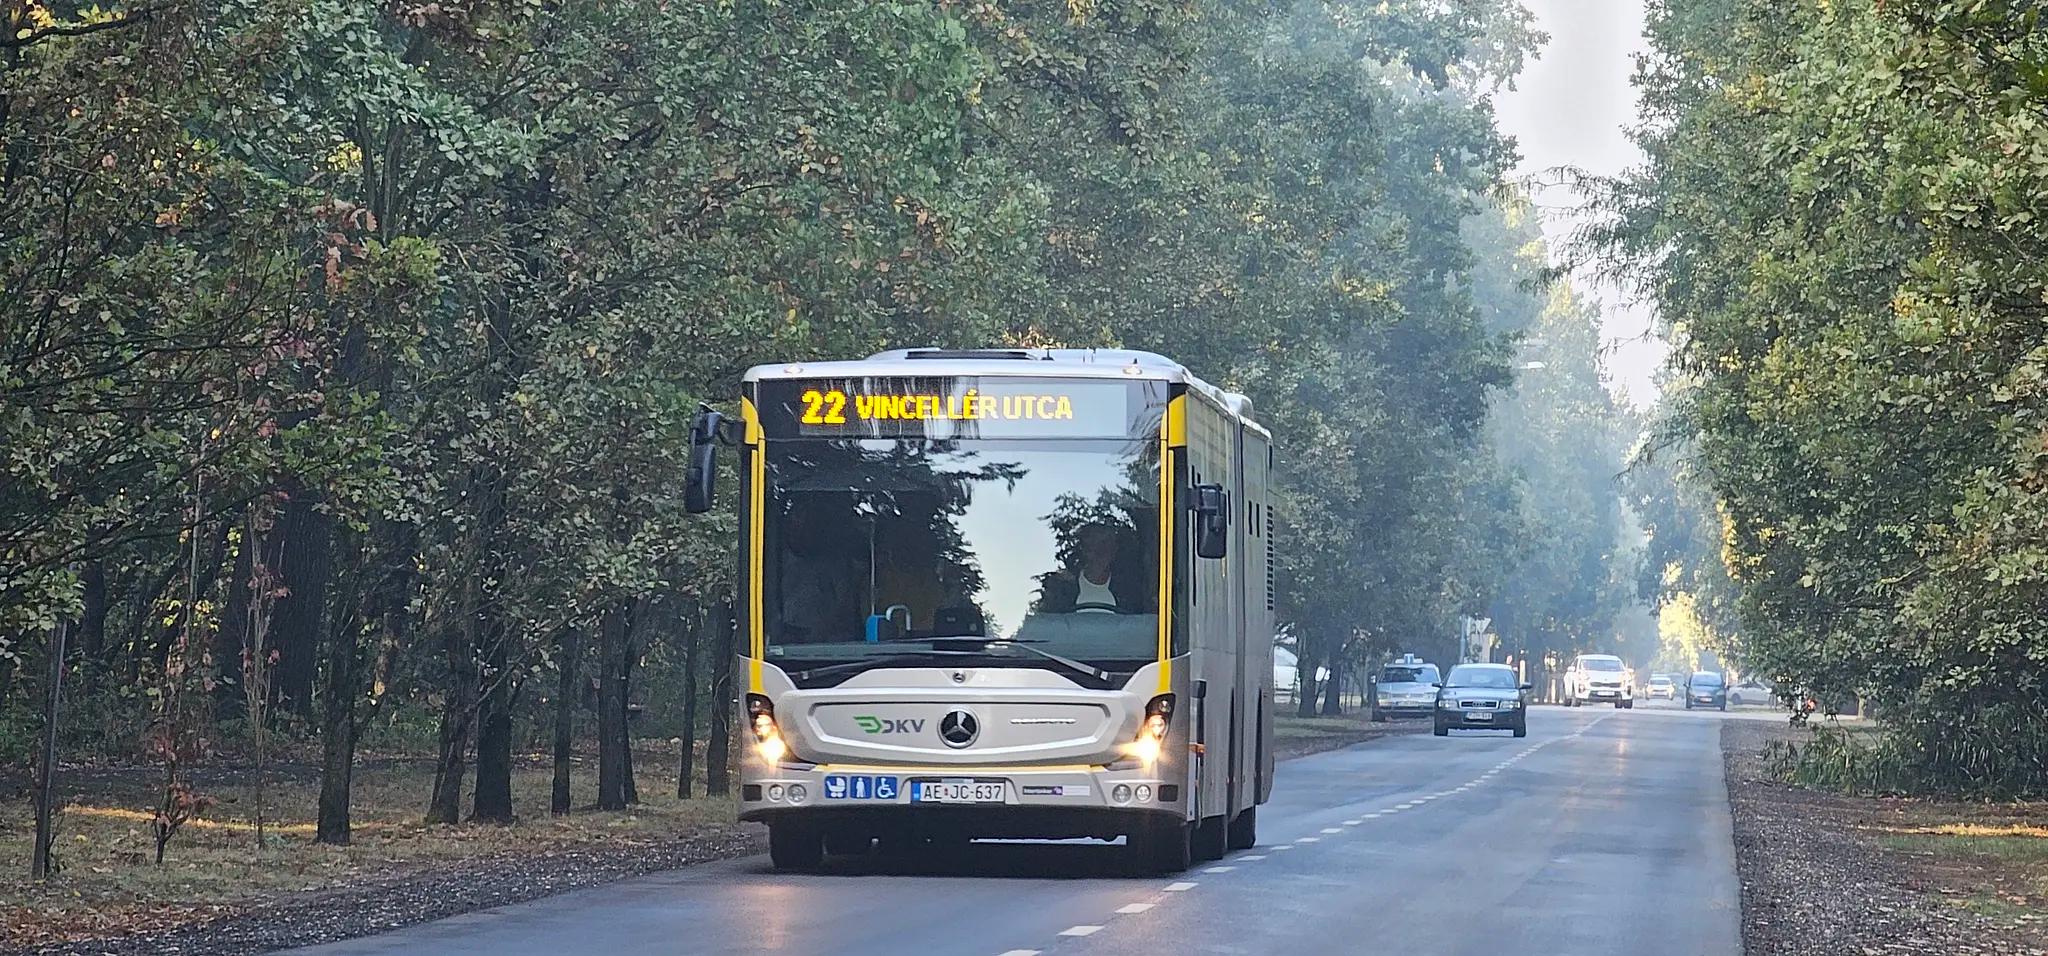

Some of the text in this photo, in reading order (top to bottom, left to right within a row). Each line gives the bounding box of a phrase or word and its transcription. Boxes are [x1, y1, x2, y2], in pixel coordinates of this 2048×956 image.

[801, 388, 1073, 424] 22 VINCELLÉR UTCA
[881, 718, 926, 734] DKV
